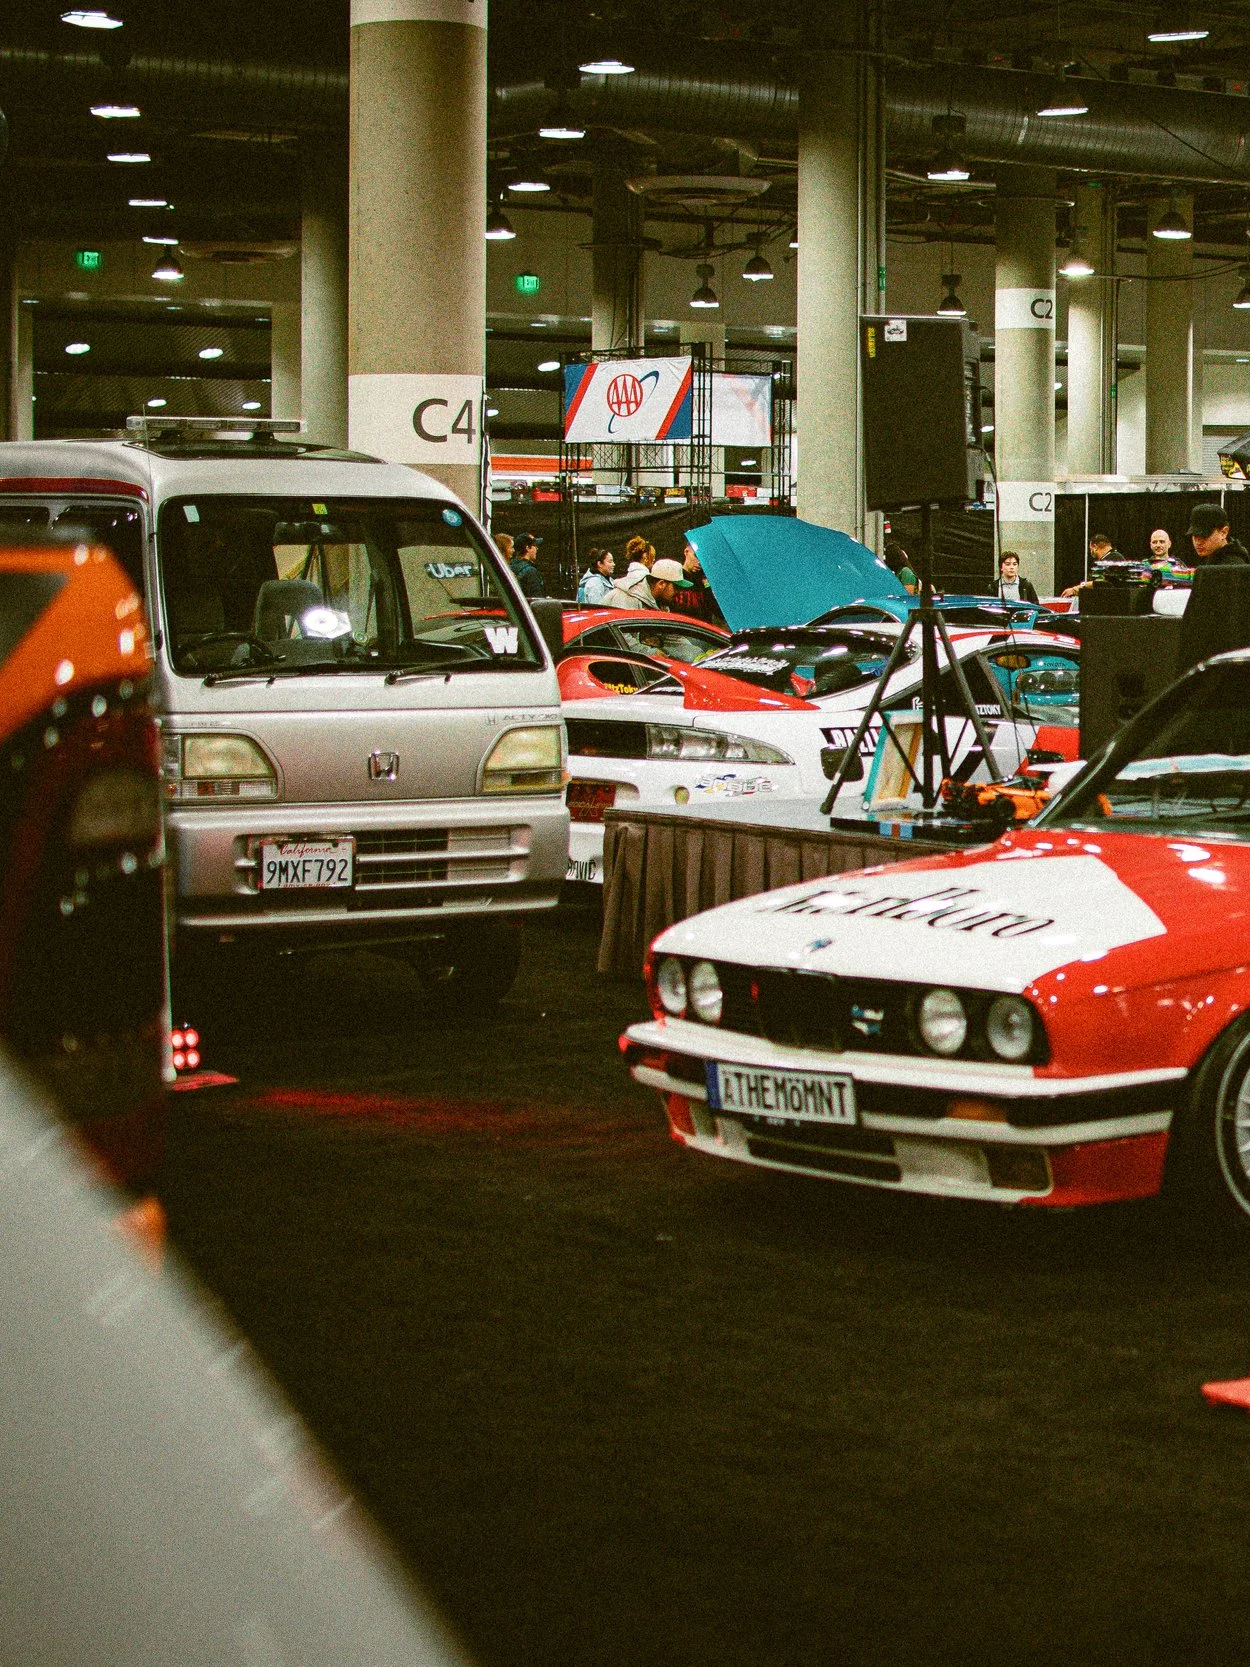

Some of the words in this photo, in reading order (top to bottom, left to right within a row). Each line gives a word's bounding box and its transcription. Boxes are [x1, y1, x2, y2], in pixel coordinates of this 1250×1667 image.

[1030, 298, 1053, 320] C2
[610, 374, 641, 416] AAA
[412, 398, 476, 444] C4
[1028, 492, 1052, 512] C2
[429, 563, 472, 579] Uber
[280, 843, 332, 858] California
[266, 858, 348, 884] 9MXF792
[755, 886, 1056, 938] Mrlboro
